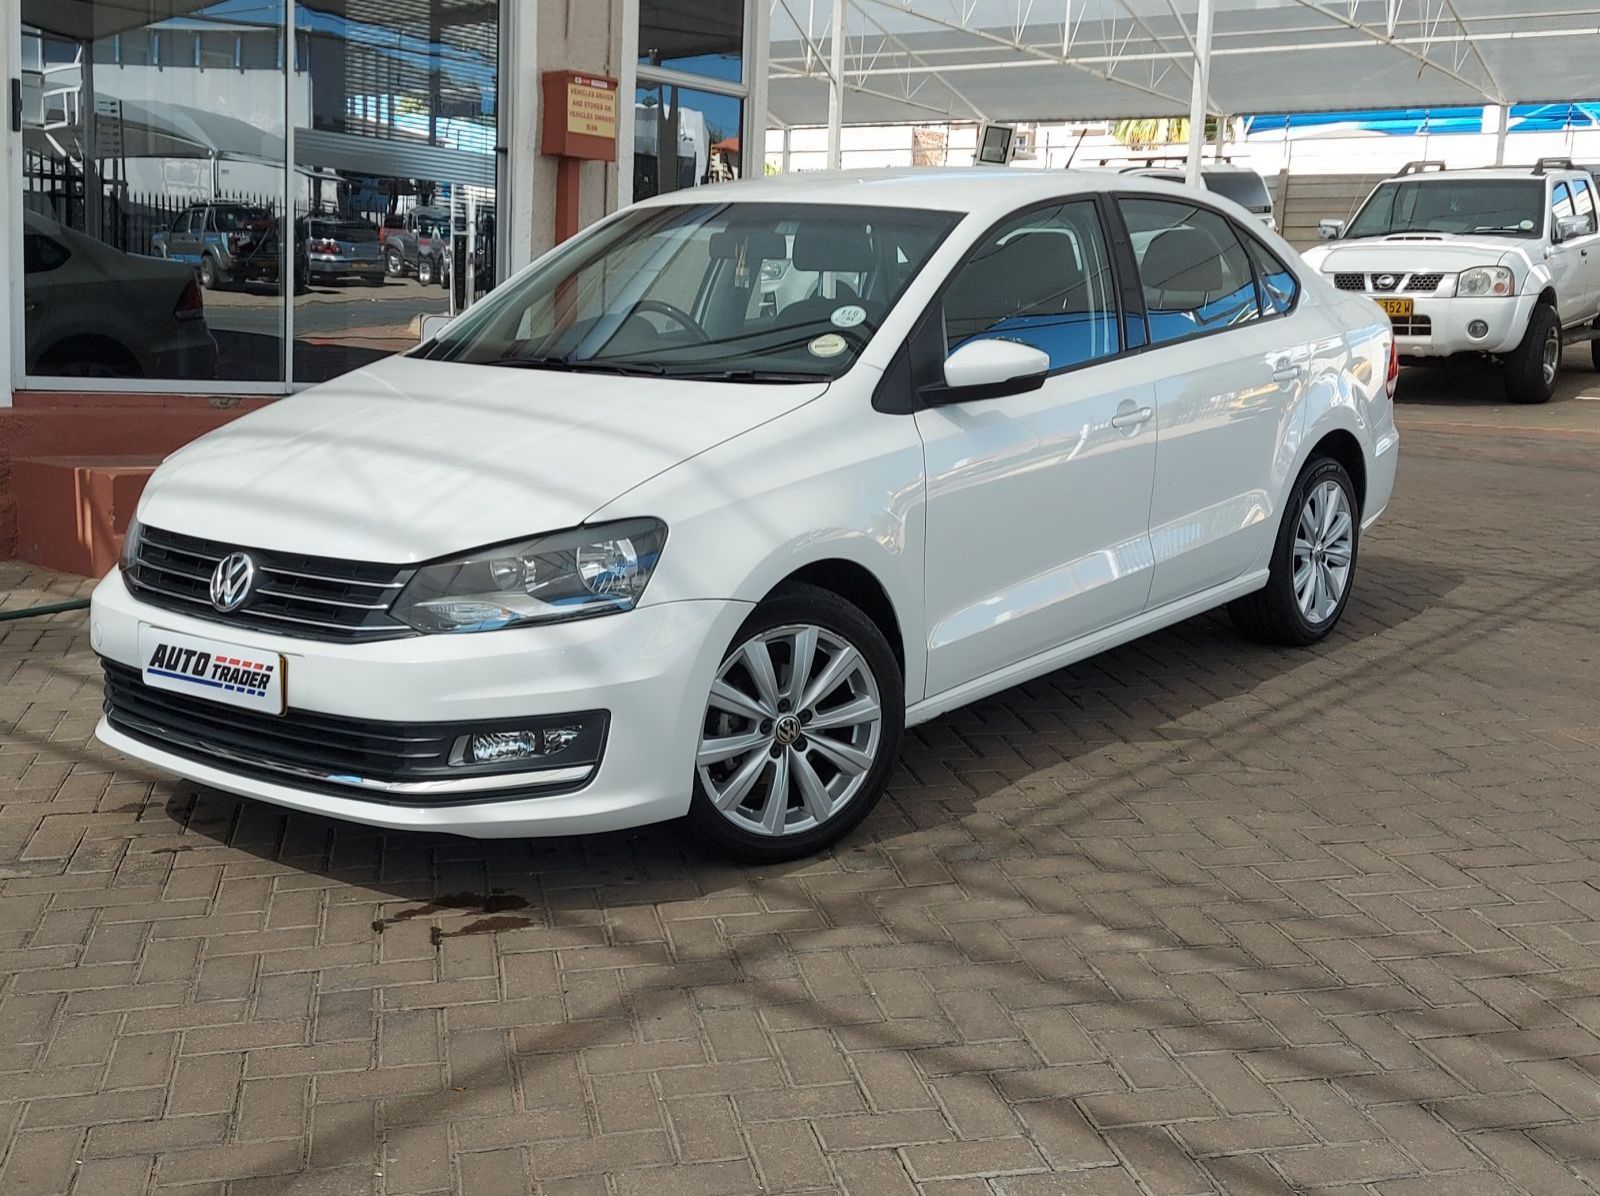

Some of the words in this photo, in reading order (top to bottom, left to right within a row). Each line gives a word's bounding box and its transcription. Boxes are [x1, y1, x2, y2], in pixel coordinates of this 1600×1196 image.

[573, 99, 583, 107] AND
[149, 643, 211, 677] AUTO
[211, 663, 271, 690] TRADER
